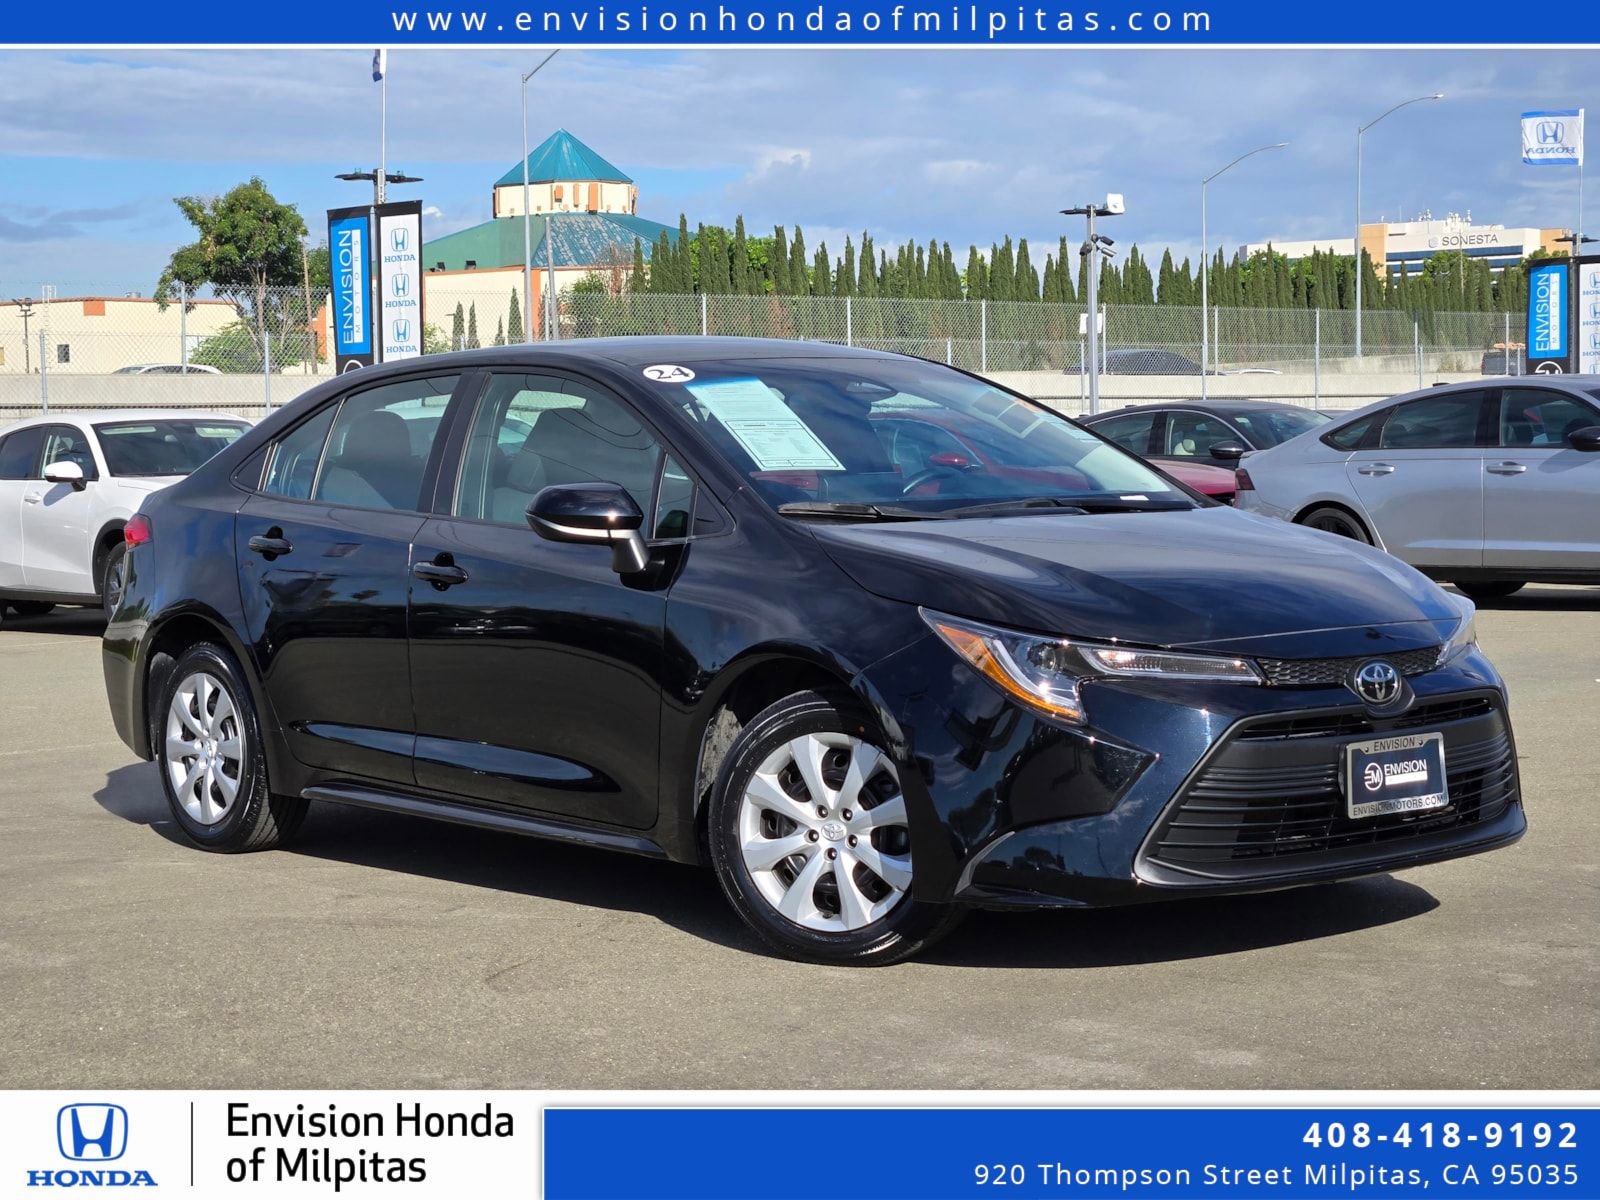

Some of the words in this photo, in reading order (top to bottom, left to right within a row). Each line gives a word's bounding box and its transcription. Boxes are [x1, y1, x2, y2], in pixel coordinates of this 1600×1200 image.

[1442, 234, 1498, 246] SONESTA
[384, 254, 416, 263] HONDA
[338, 230, 354, 344] ENVISION
[385, 300, 417, 309] HONDA
[1536, 273, 1550, 352] ENVISION
[386, 345, 418, 354] HONDA
[648, 367, 690, 380] 24
[1373, 737, 1416, 752] ENVISION
[1384, 759, 1427, 776] ENVISION
